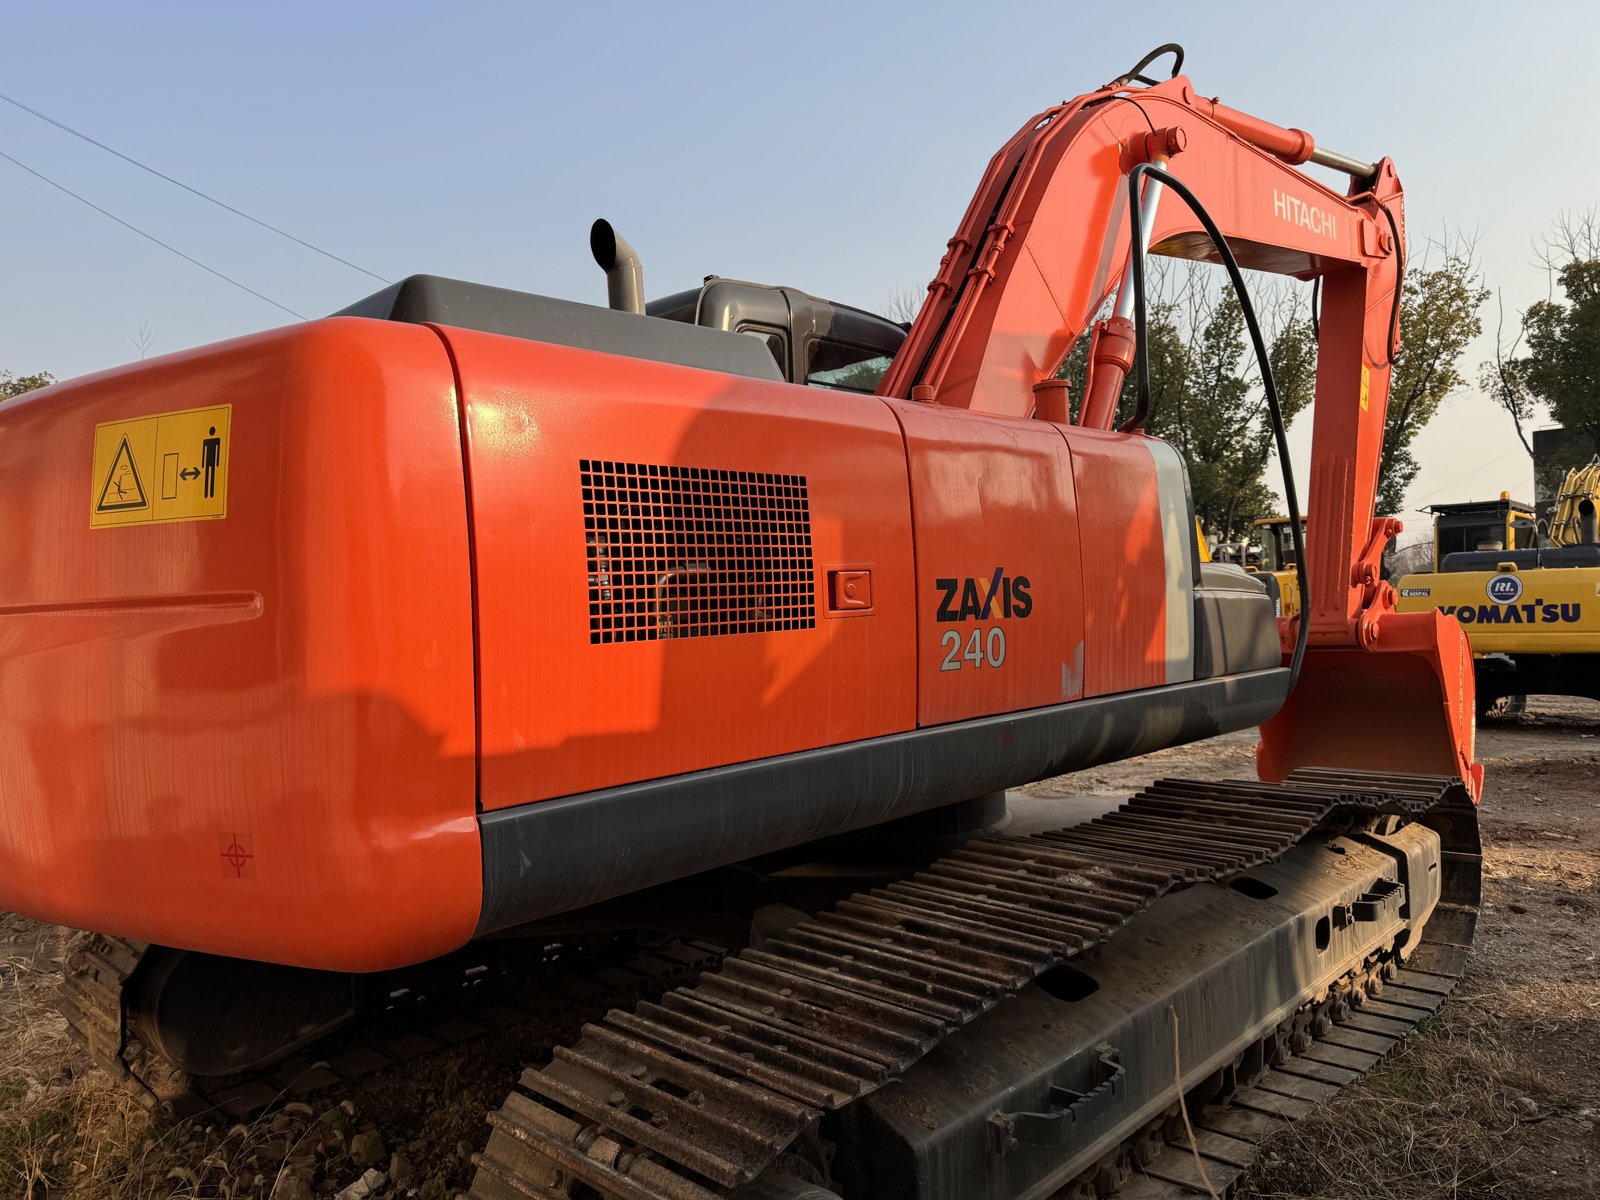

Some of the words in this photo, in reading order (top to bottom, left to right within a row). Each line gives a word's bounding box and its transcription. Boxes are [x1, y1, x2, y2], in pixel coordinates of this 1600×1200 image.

[1273, 188, 1337, 240] HITACHI
[935, 567, 1033, 622] ZAXIS
[940, 626, 1007, 672] 240
